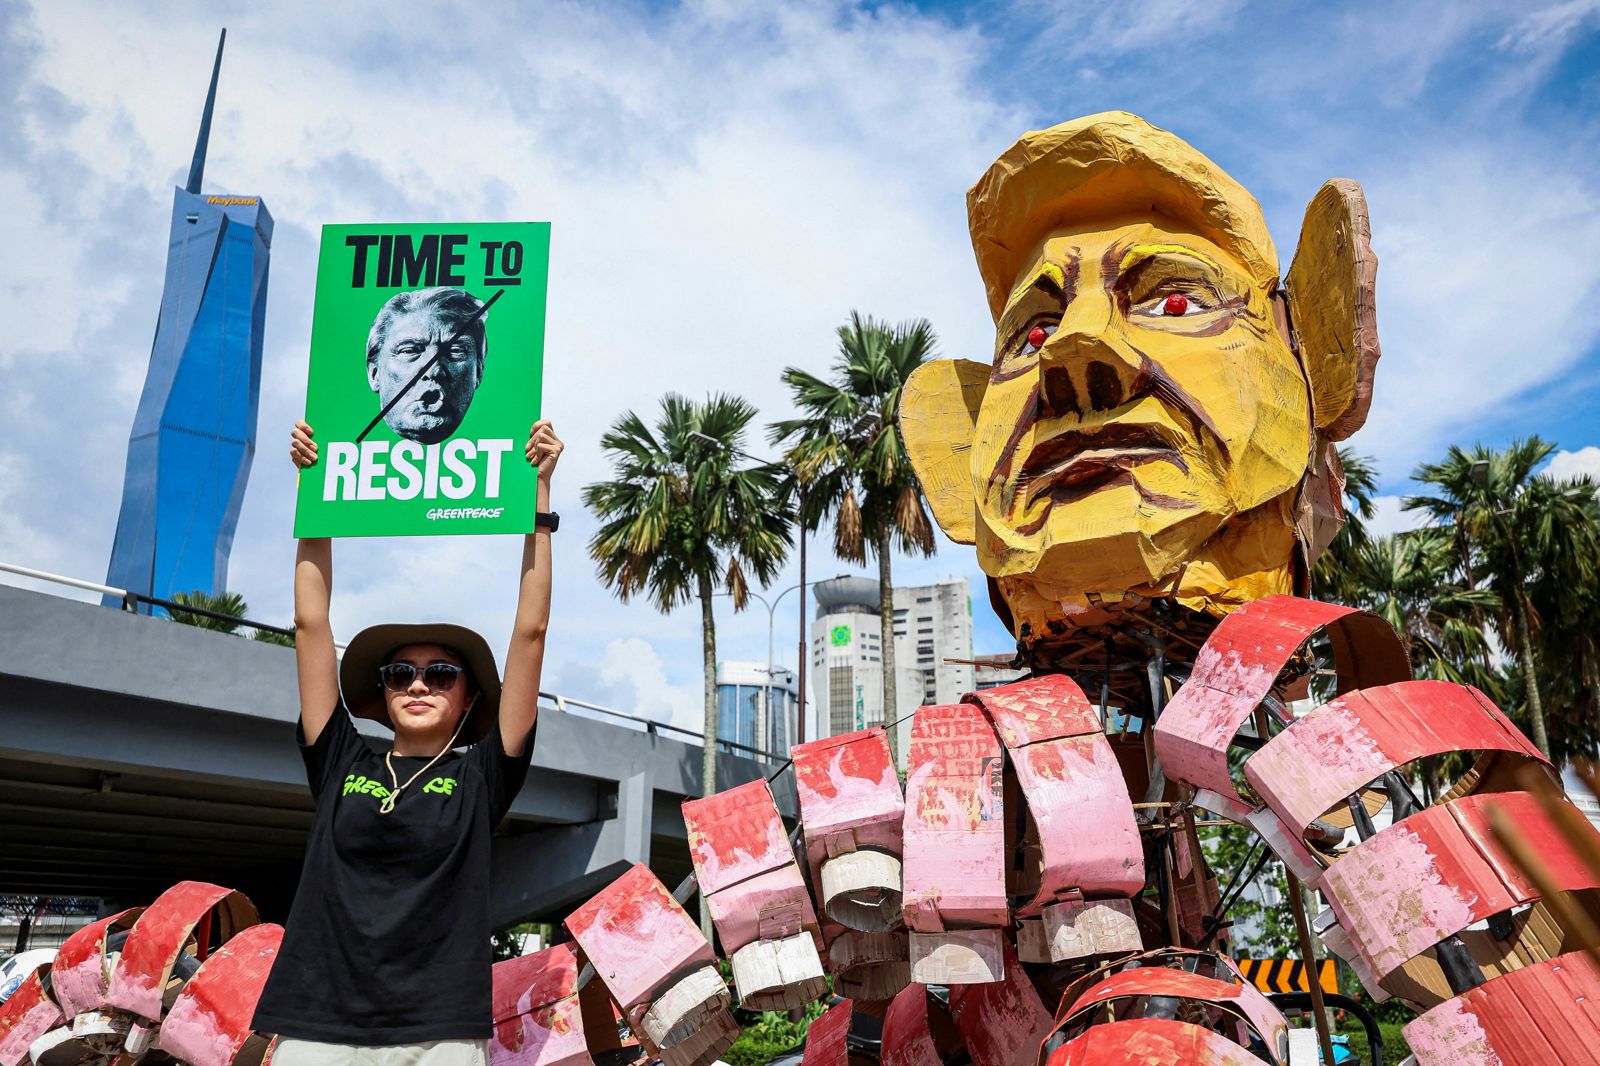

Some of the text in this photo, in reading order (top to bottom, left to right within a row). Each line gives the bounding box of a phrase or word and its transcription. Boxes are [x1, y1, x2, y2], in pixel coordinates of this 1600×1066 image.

[345, 234, 523, 288] TIME TO
[322, 438, 513, 502] RESIST
[426, 507, 505, 520] GREENPEACE
